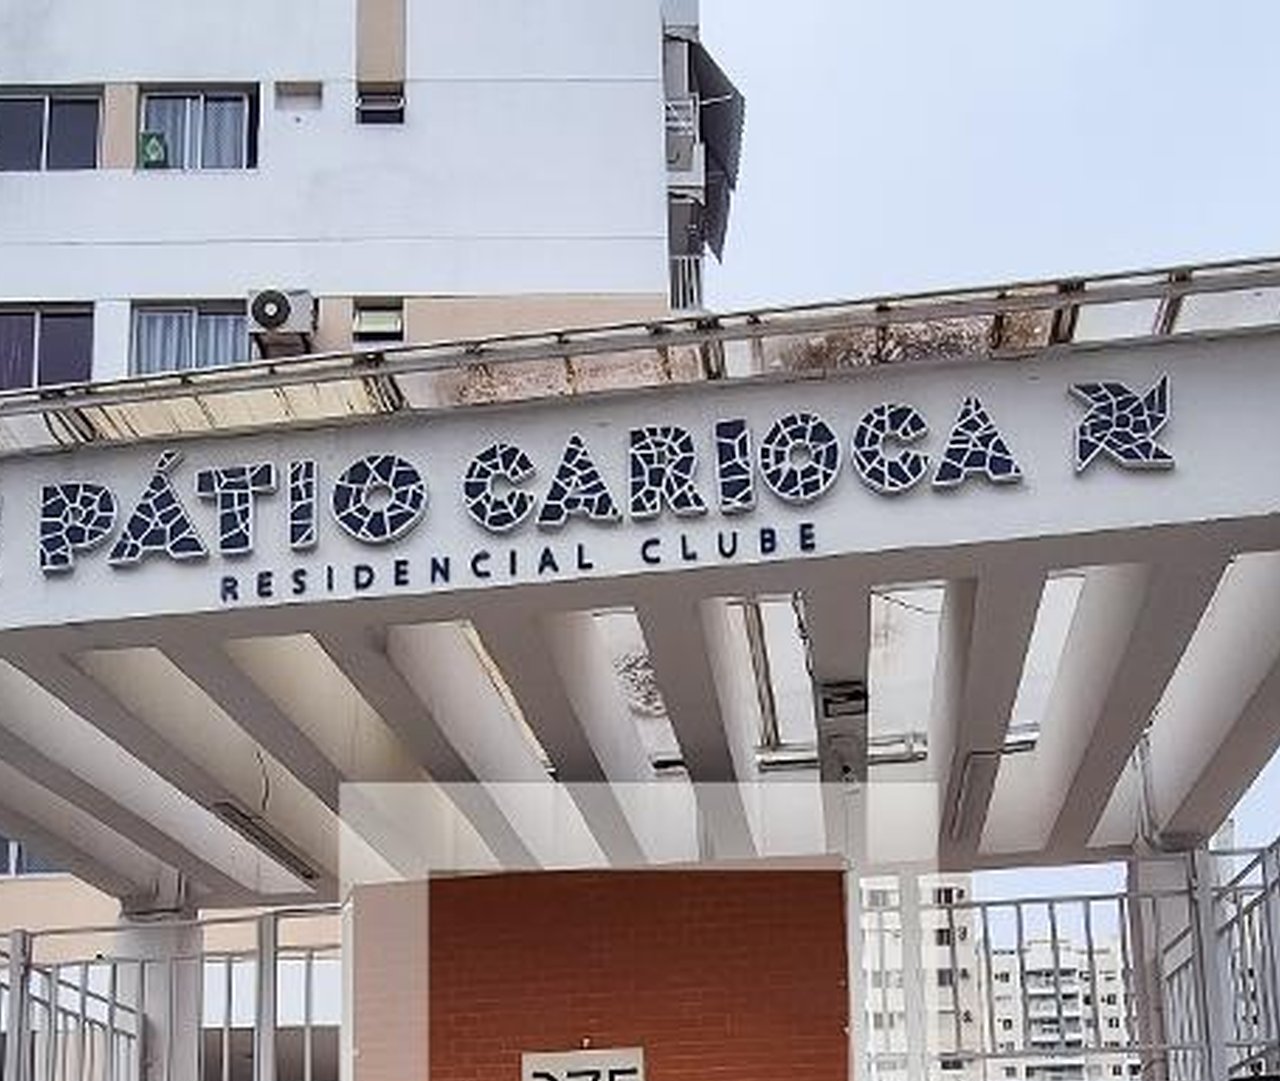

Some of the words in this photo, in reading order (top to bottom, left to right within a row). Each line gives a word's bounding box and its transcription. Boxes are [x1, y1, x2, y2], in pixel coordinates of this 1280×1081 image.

[39, 449, 428, 574] PÁTIO
[462, 396, 1024, 534] CARIOCA
[221, 544, 595, 601] RESIDENCIAL
[641, 523, 818, 564] CLUBE
